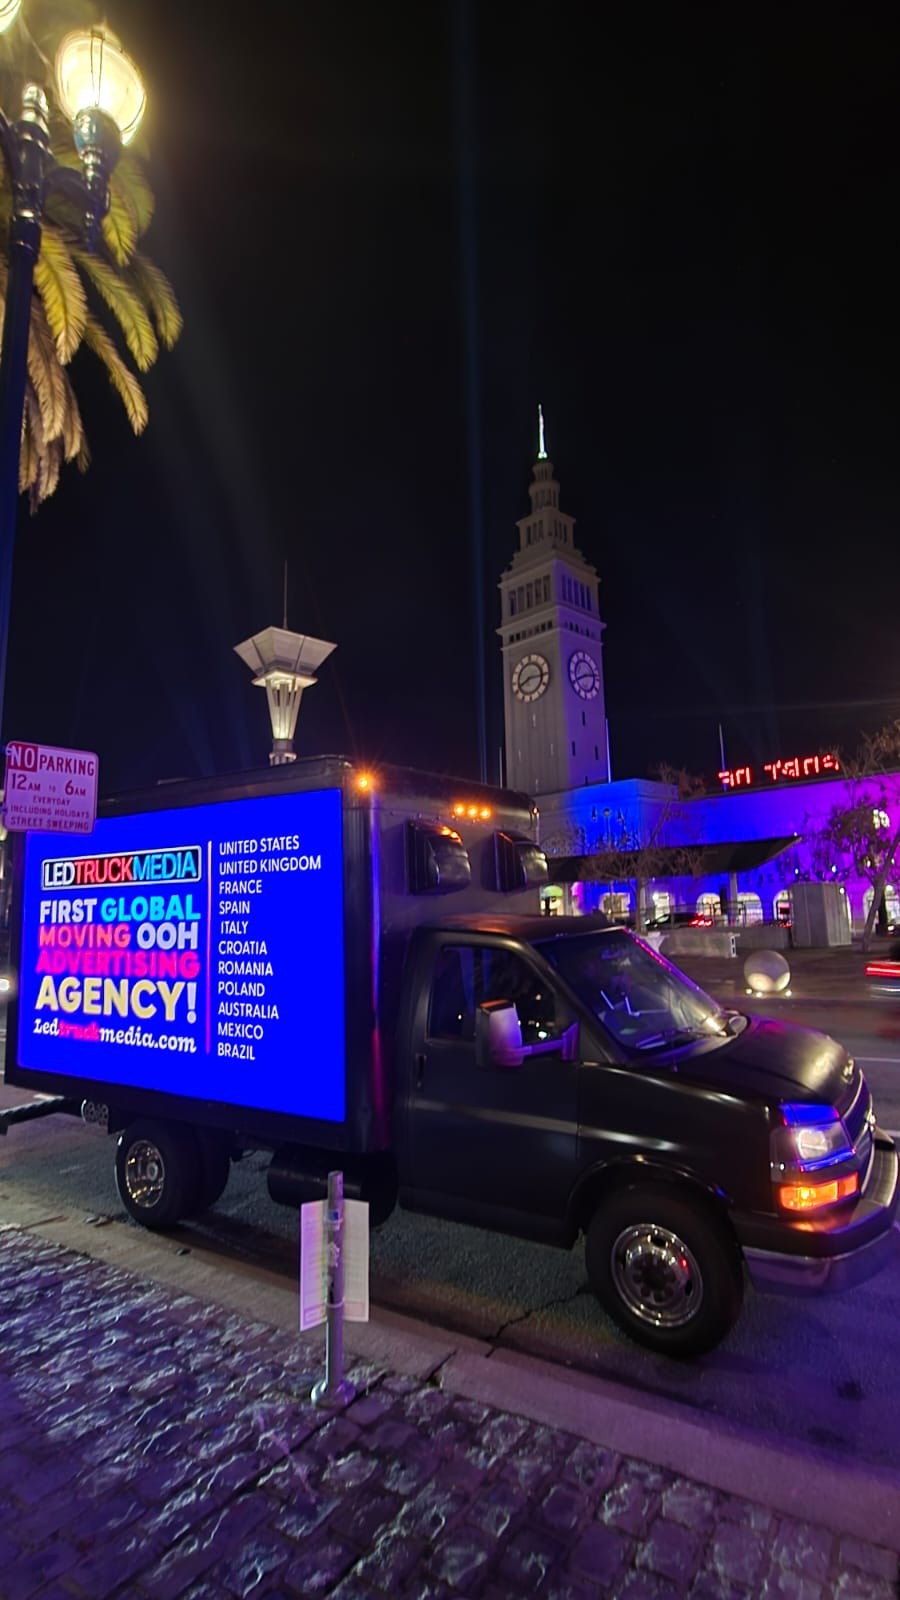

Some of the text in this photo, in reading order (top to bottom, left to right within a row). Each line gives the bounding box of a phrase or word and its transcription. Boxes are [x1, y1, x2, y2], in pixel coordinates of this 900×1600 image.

[10, 745, 95, 777] NO PARKING
[32, 795, 71, 806] EVERYDAY
[10, 804, 90, 819] INCLUDING HOLIDAYS
[10, 816, 89, 831] STREET SWEEPING
[219, 834, 300, 856] UNITED STATES
[219, 854, 322, 876] UNITED KINGDOM
[219, 879, 263, 895] FRANCE
[39, 894, 201, 924] FIRST GLOBAL
[219, 900, 251, 915] SPAIN
[39, 921, 198, 950] MOVING OOH
[220, 920, 249, 935] ITALY
[218, 940, 268, 956] CROATIA
[35, 949, 200, 979] ADVERTISING
[218, 960, 274, 977] ROMANIA
[217, 980, 266, 998] POLAND
[34, 975, 197, 1025] AGENCY!
[218, 1001, 280, 1020] AUSTRALIA
[32, 1017, 197, 1054] Ledtruckmedia.com
[217, 1021, 264, 1040] MEXICO
[217, 1042, 256, 1061] BRAZIL
